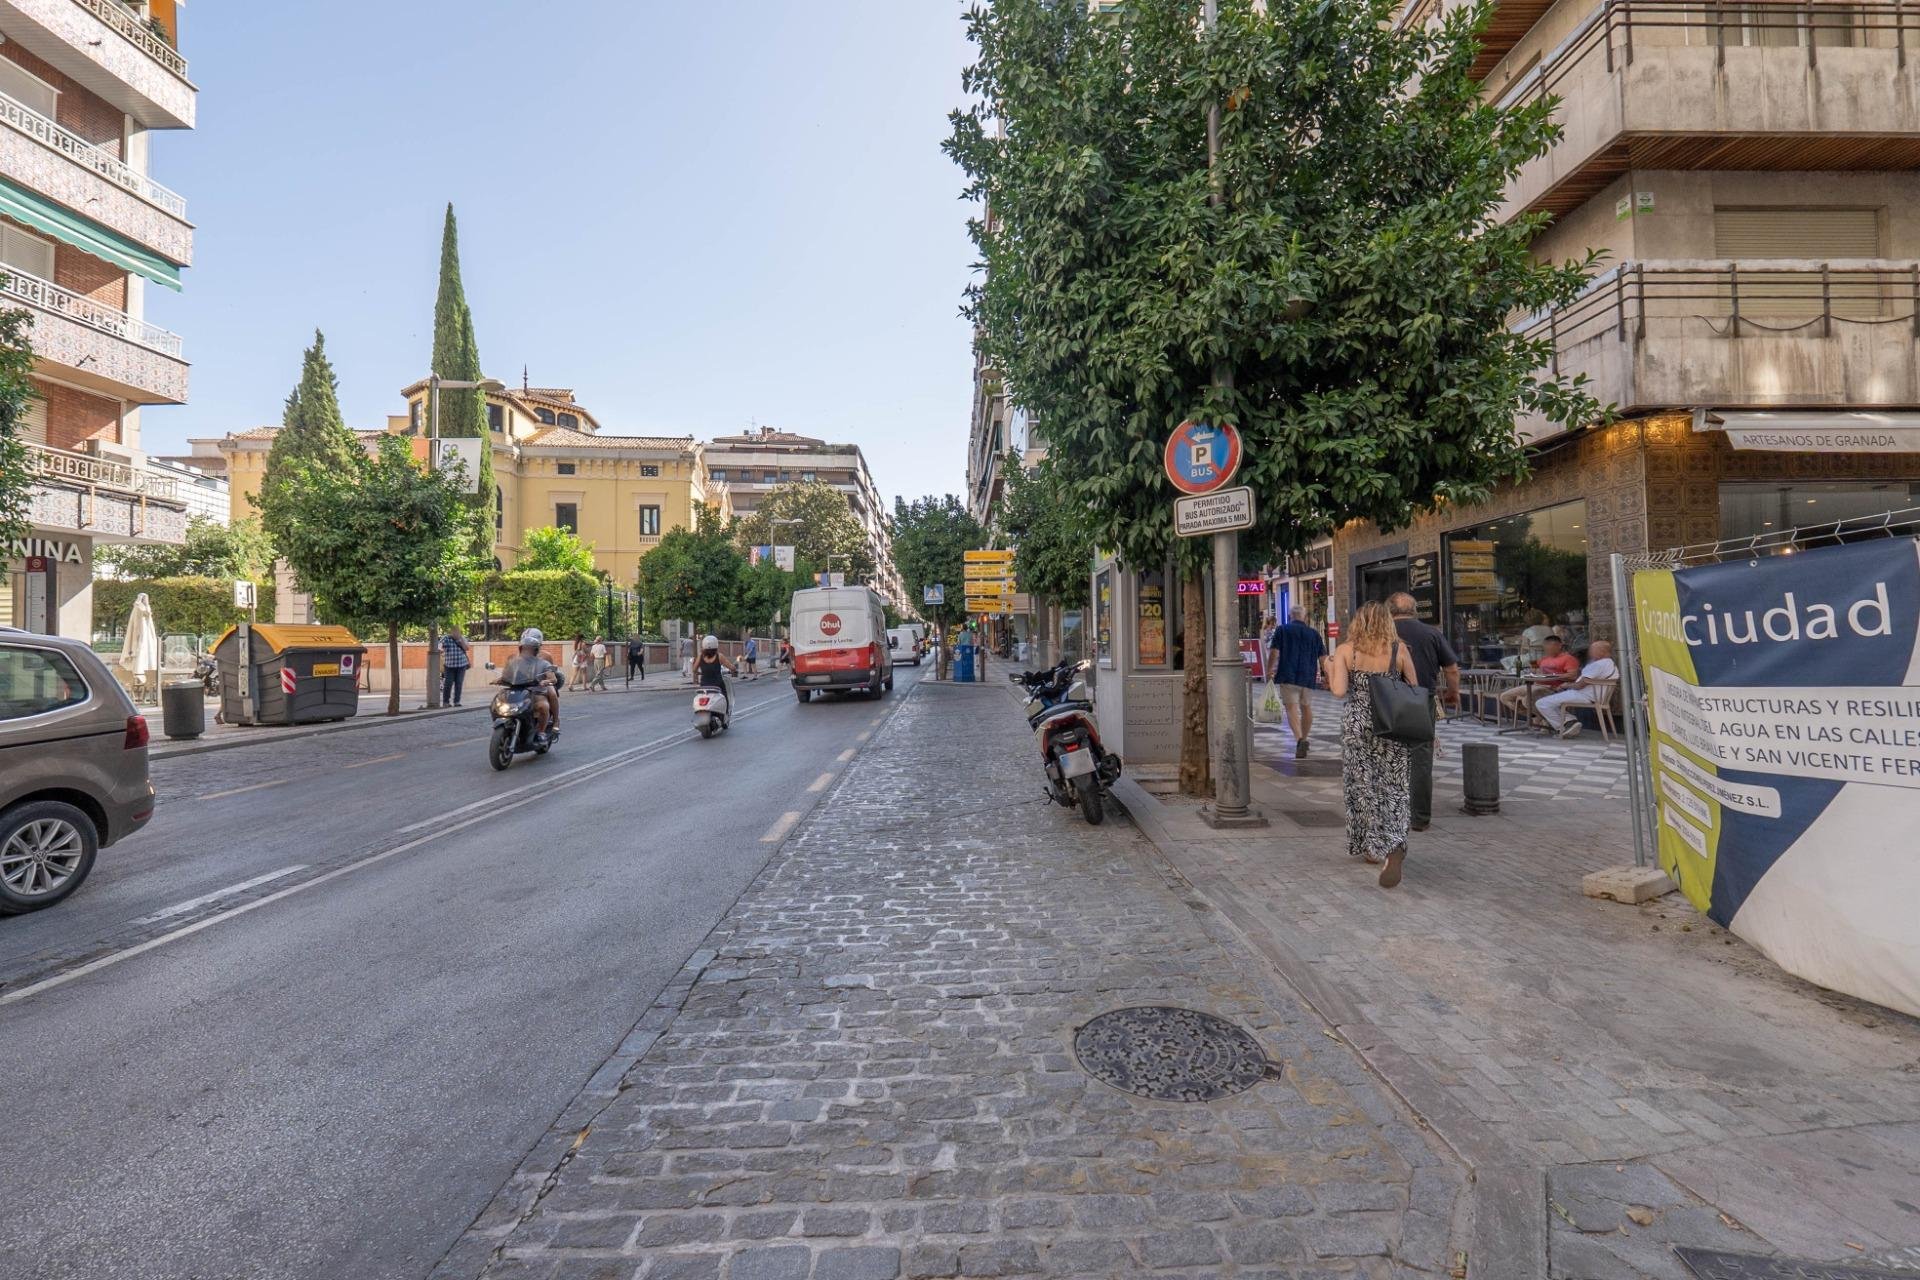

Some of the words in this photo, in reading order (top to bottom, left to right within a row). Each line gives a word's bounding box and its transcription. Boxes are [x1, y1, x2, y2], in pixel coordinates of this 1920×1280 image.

[1743, 435, 1813, 447] ARTESANOS
[1816, 435, 1832, 447] DE
[1835, 435, 1897, 447] GRANADA
[1195, 447, 1208, 463] P
[1191, 466, 1213, 477] BUS
[1193, 495, 1231, 509] PERMITIDO
[1185, 510, 1199, 520] BUS
[1199, 504, 1241, 519] AUTORIZADO
[1180, 519, 1202, 530] PARADA
[1228, 515, 1233, 523] 5
[0, 536, 83, 564] NINA
[1139, 603, 1161, 617] 120
[1681, 582, 1892, 646] ciudad
[821, 620, 841, 629] Dhul
[1689, 690, 1822, 715] ESTRUCTURAS
[1826, 699, 1839, 716] Y
[1719, 722, 1770, 739] AGUA
[1775, 724, 1801, 741] EN
[1807, 725, 1843, 743] LAS
[1849, 728, 1920, 747] CALLE
[1730, 746, 1740, 761] Y
[1746, 746, 1781, 765] SAN
[1786, 750, 1875, 773] VICENTE
[1745, 796, 1770, 809] S.L.
